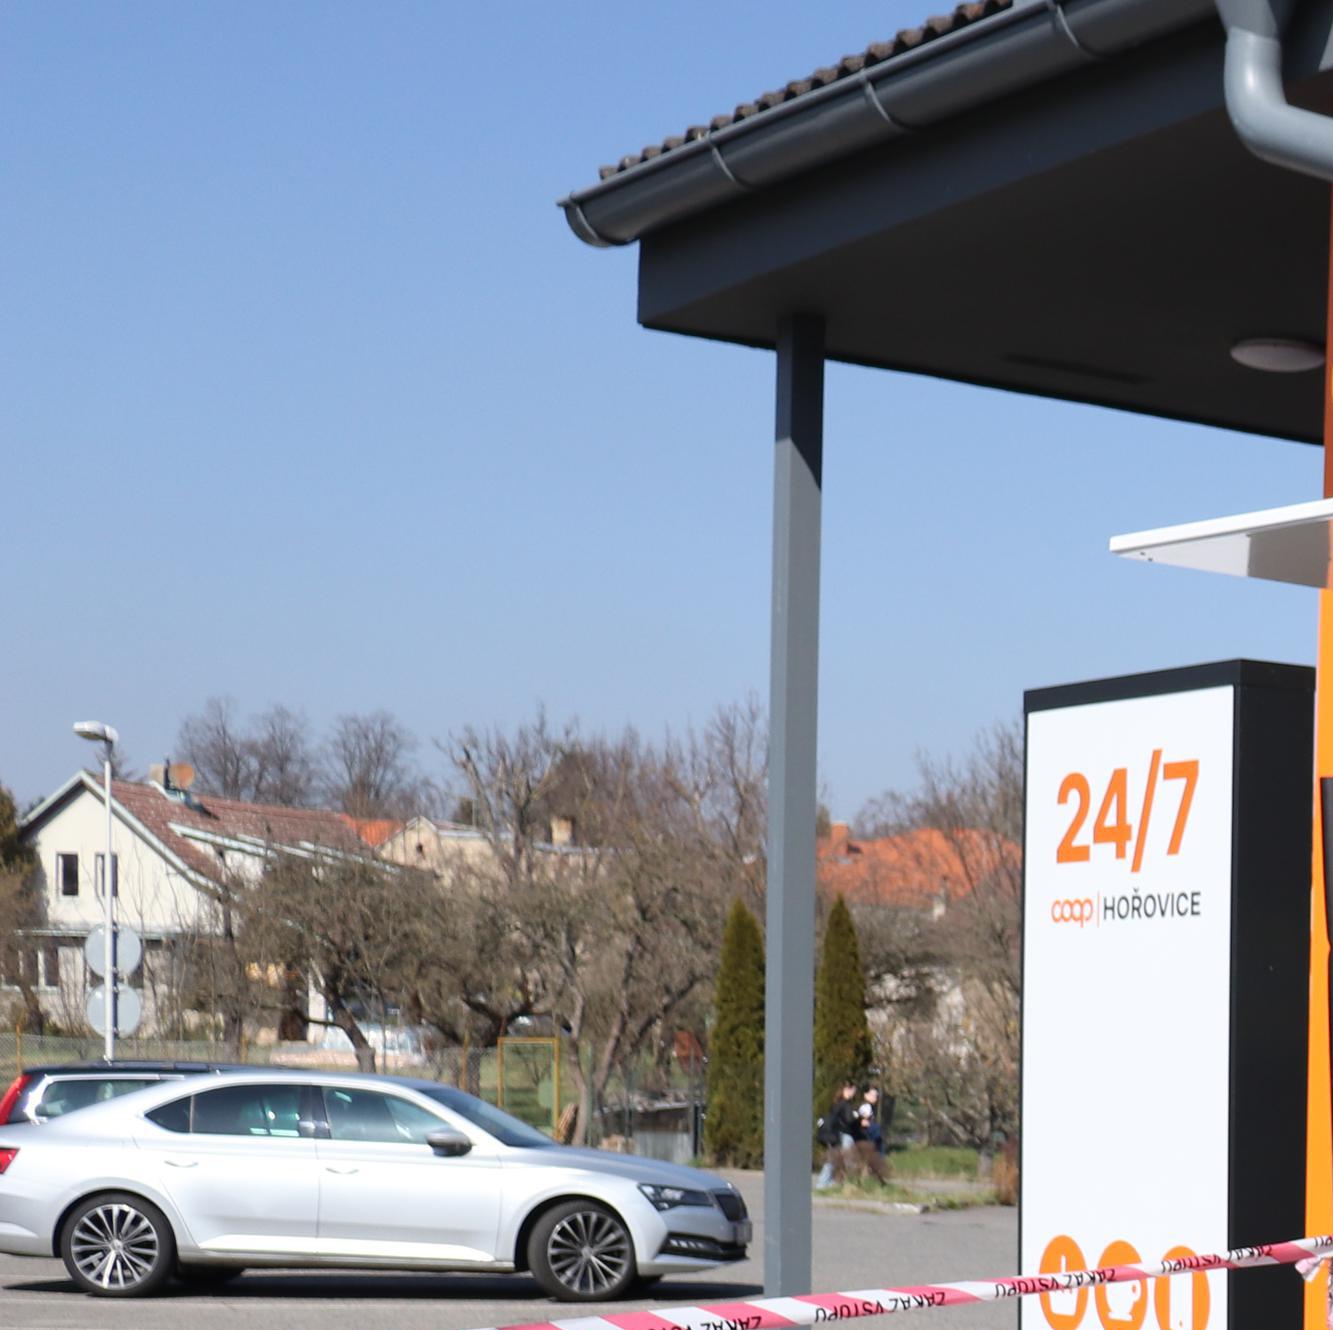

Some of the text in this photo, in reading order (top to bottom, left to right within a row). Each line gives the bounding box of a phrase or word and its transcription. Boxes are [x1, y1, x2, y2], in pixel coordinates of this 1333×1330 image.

[1056, 748, 1200, 873] 24/7
[1051, 886, 1202, 929] coop HOŘOVICE
